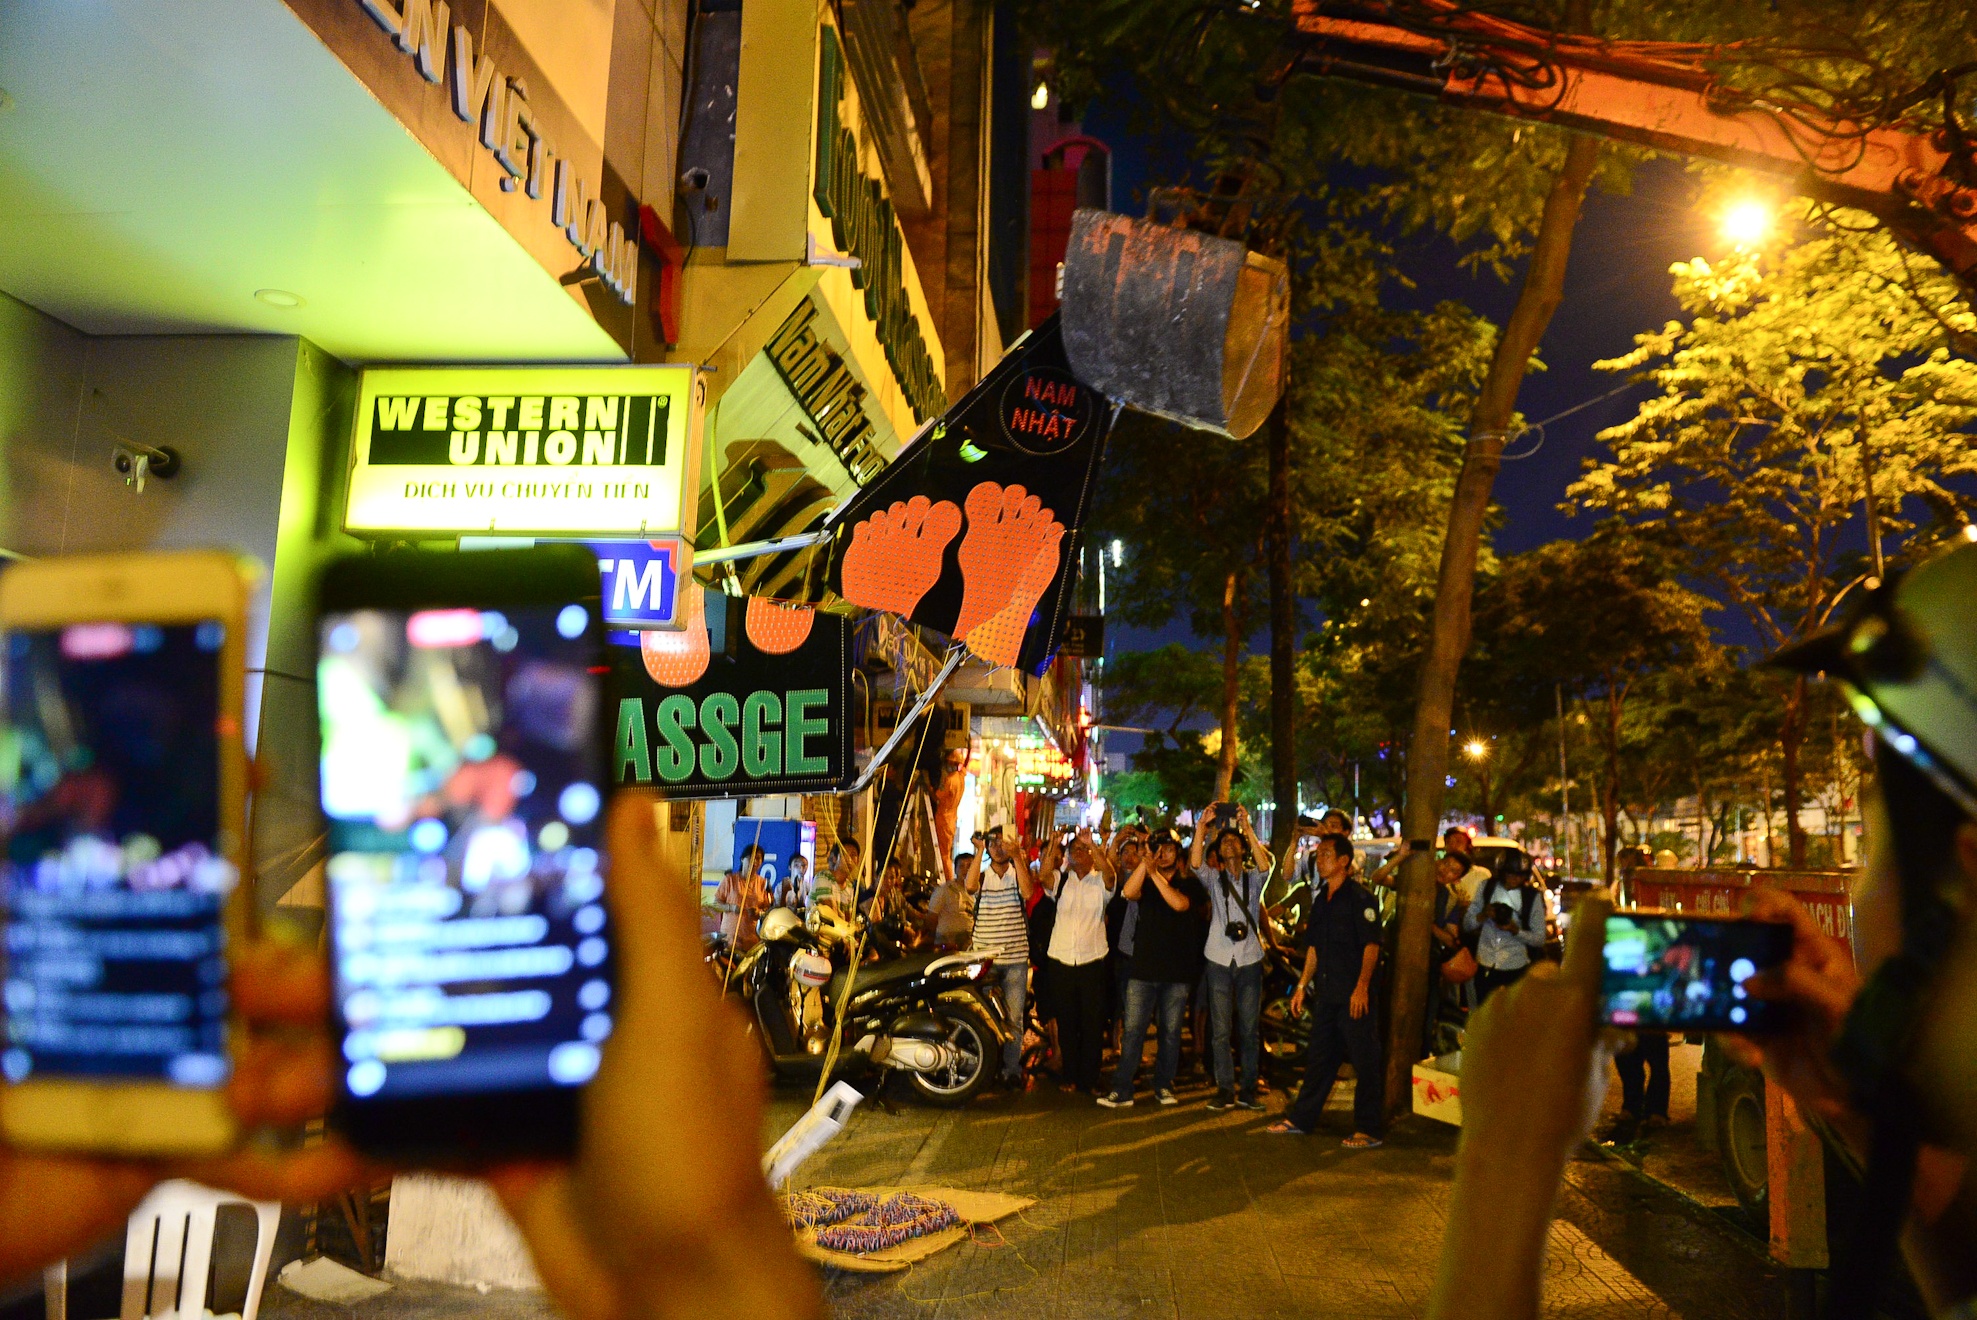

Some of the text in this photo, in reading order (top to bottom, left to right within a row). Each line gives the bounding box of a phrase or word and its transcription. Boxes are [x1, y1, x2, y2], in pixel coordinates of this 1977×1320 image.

[554, 158, 638, 305] NAM
[764, 295, 832, 398] Nam
[1025, 376, 1077, 407] NAM
[377, 396, 619, 431] WESTERN
[1011, 407, 1077, 442] NHẬT
[448, 430, 617, 465] UNION
